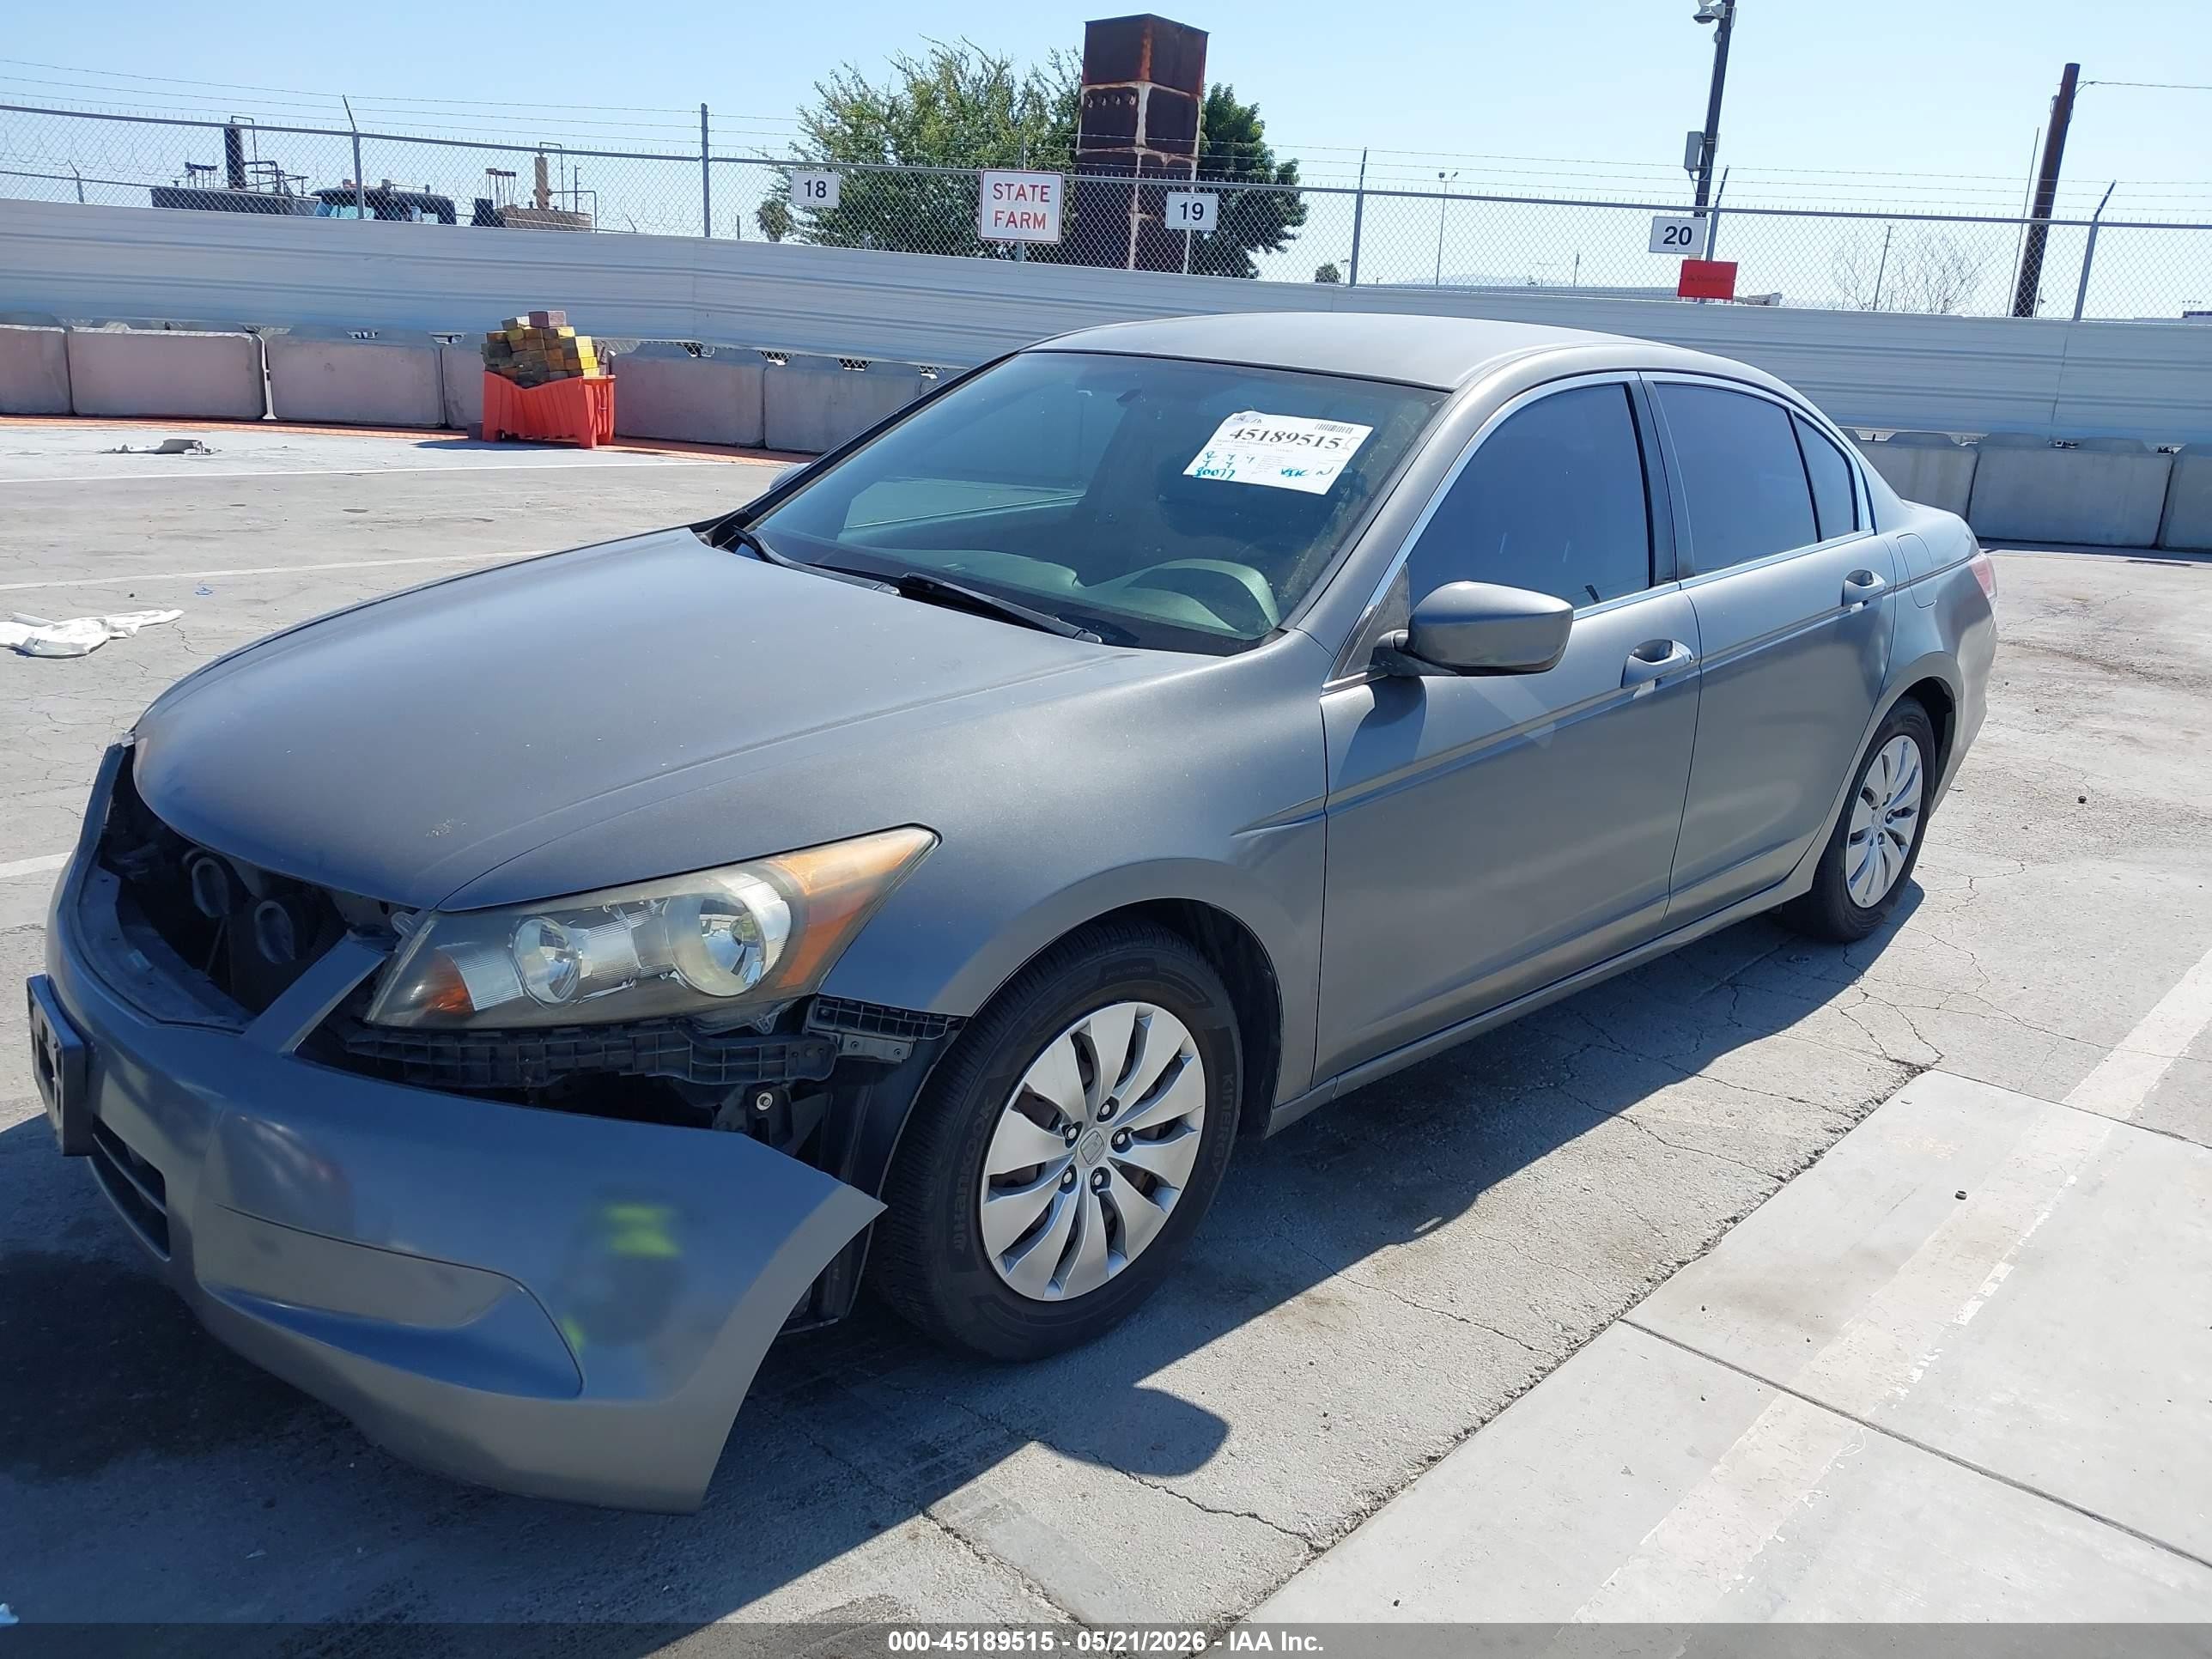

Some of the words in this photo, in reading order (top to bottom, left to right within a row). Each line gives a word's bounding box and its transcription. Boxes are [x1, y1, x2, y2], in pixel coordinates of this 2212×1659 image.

[804, 179, 827, 198] 18
[993, 183, 1051, 203] STATE
[994, 210, 1047, 230] FARM
[1179, 202, 1205, 221] 19
[1662, 226, 1692, 246] 20
[1229, 428, 1343, 449] 45189515
